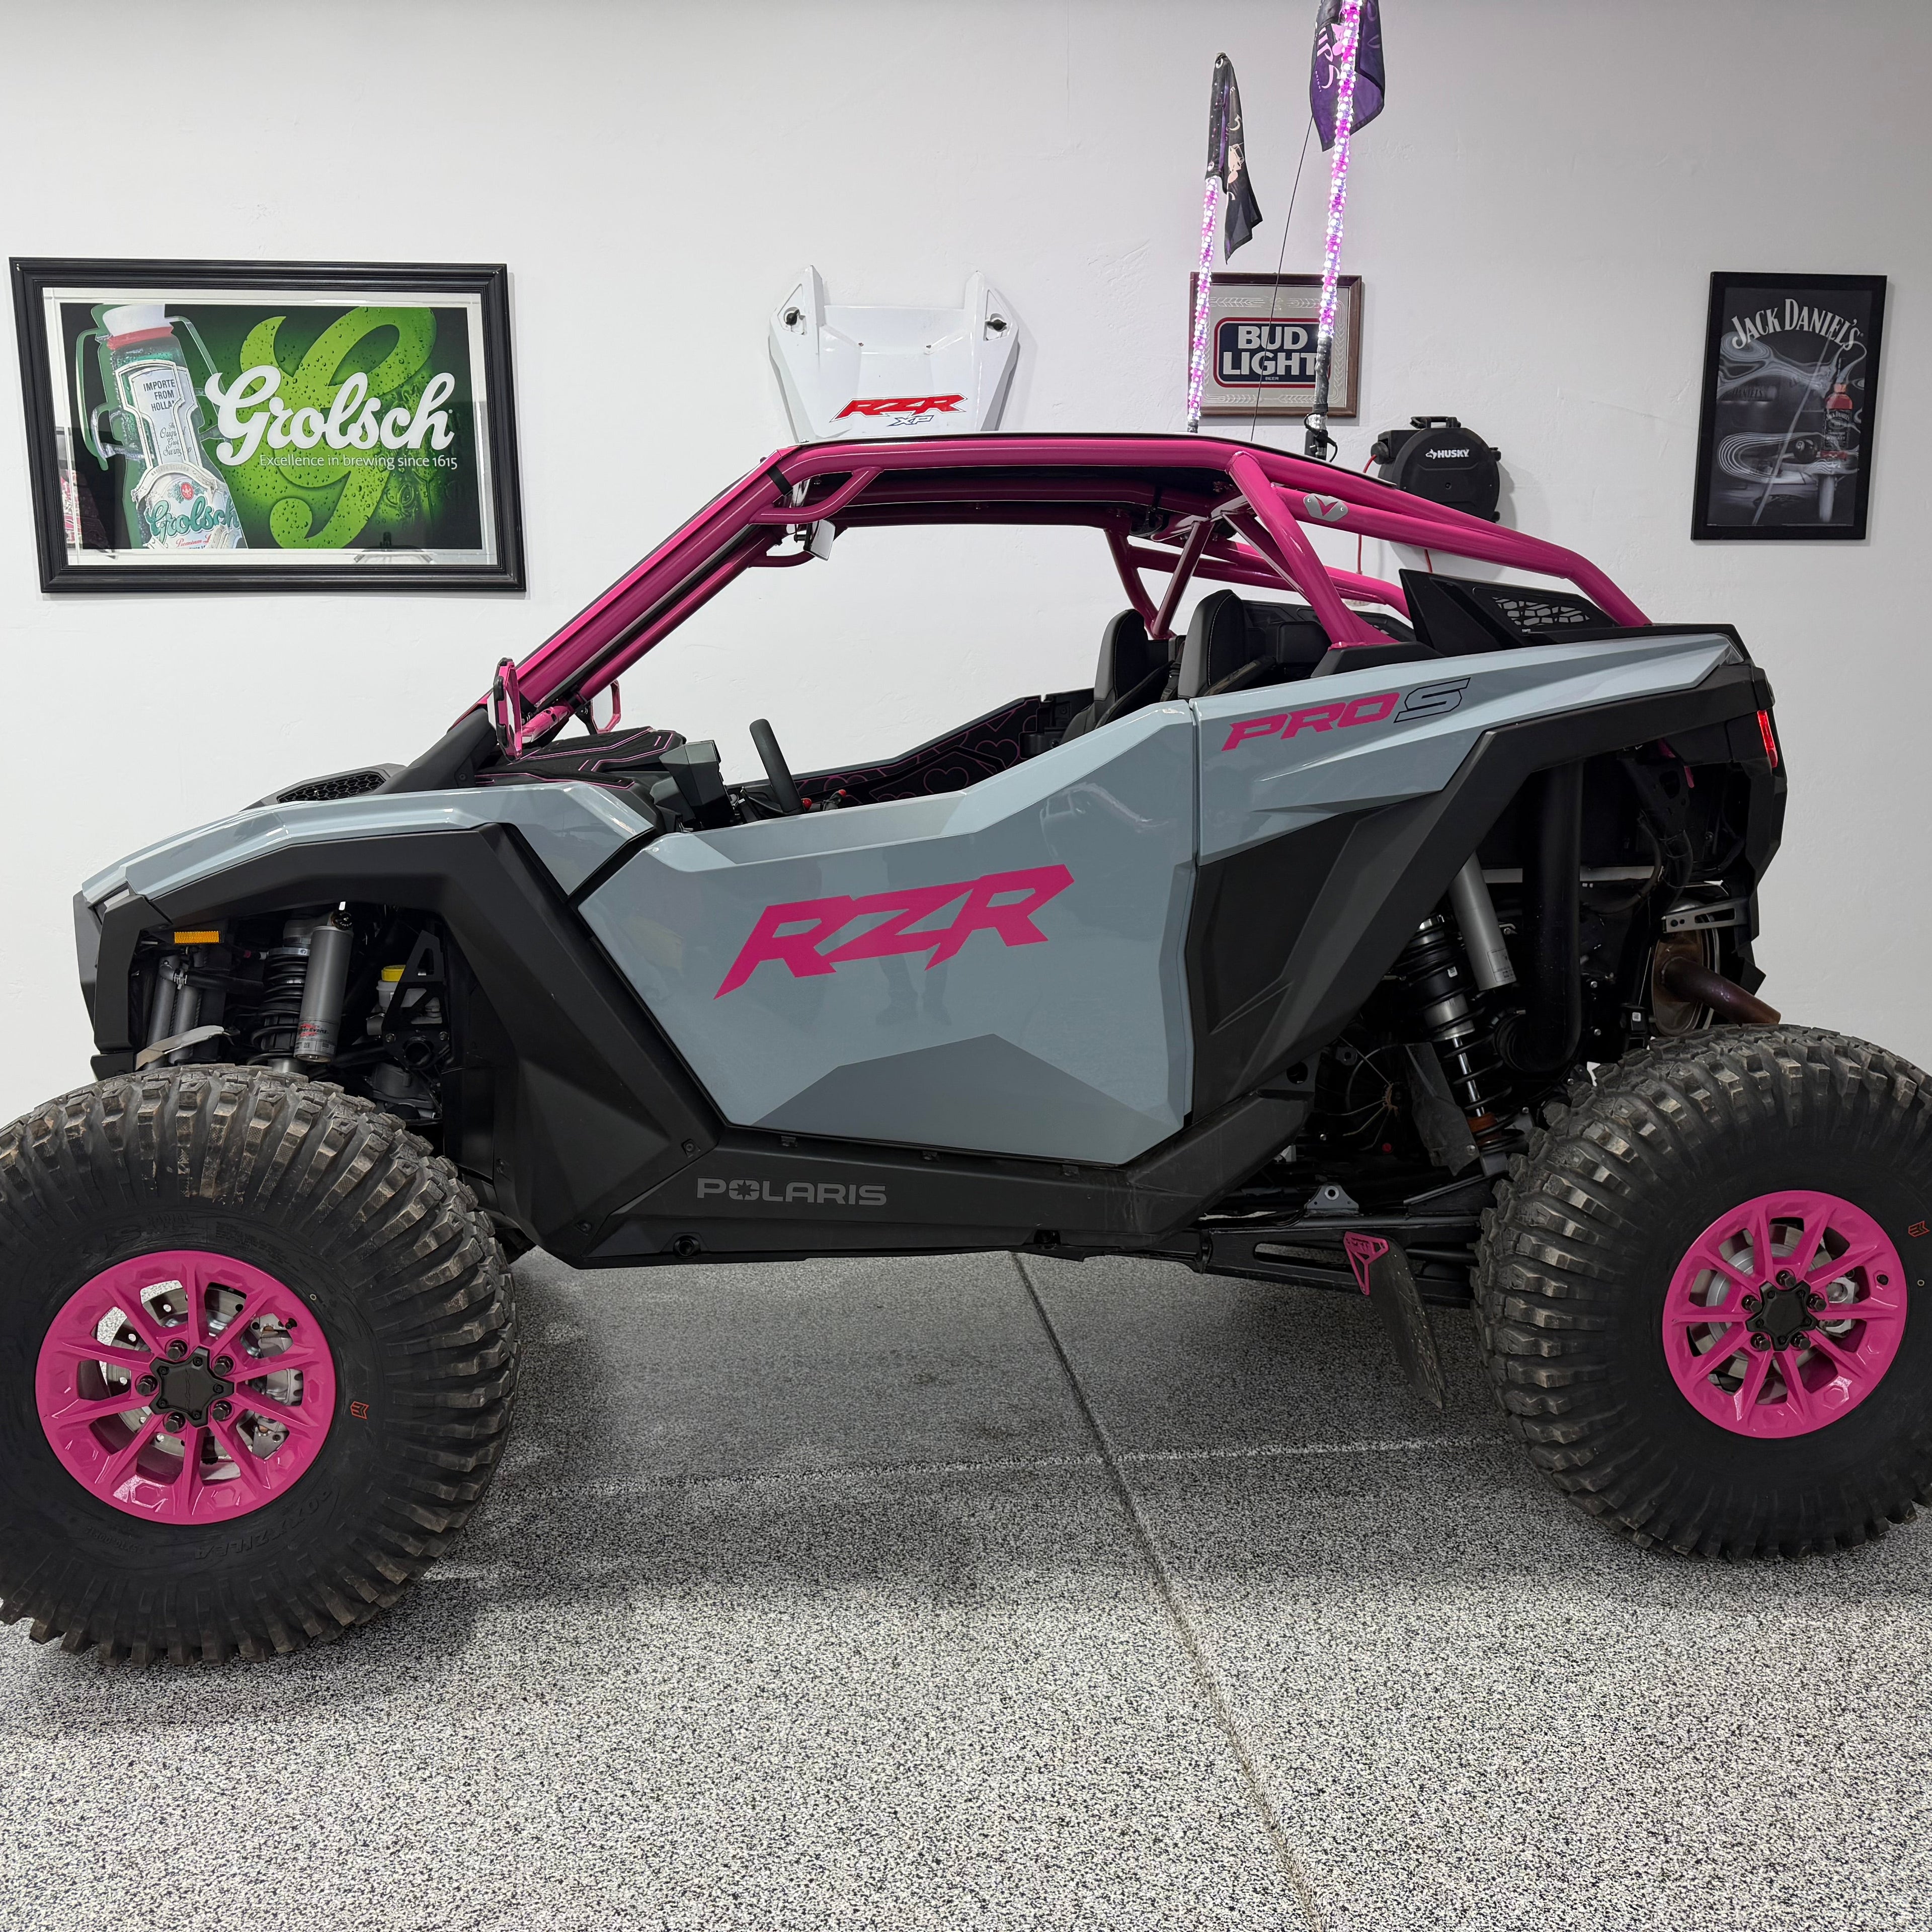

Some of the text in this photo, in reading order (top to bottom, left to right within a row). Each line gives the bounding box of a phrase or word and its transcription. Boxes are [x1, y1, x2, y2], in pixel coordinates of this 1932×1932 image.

[1731, 299, 1860, 351] JACK DANIEL'S
[1238, 326, 1308, 350] BUD
[1223, 351, 1316, 375] LIGHT
[143, 379, 176, 391] IMPORTE
[154, 389, 175, 400] FROM
[151, 400, 176, 412] HOLLA
[204, 365, 455, 466] Grolsch
[830, 393, 967, 422] RZR
[887, 415, 934, 427] XP
[260, 454, 457, 470] Excellence in brewing since 1615
[1437, 449, 1470, 458] HUSKY
[145, 496, 240, 544] Grolsch
[1221, 677, 1471, 752] PRO S
[713, 864, 1074, 1000] RZR
[697, 1178, 887, 1205] POLARIS
